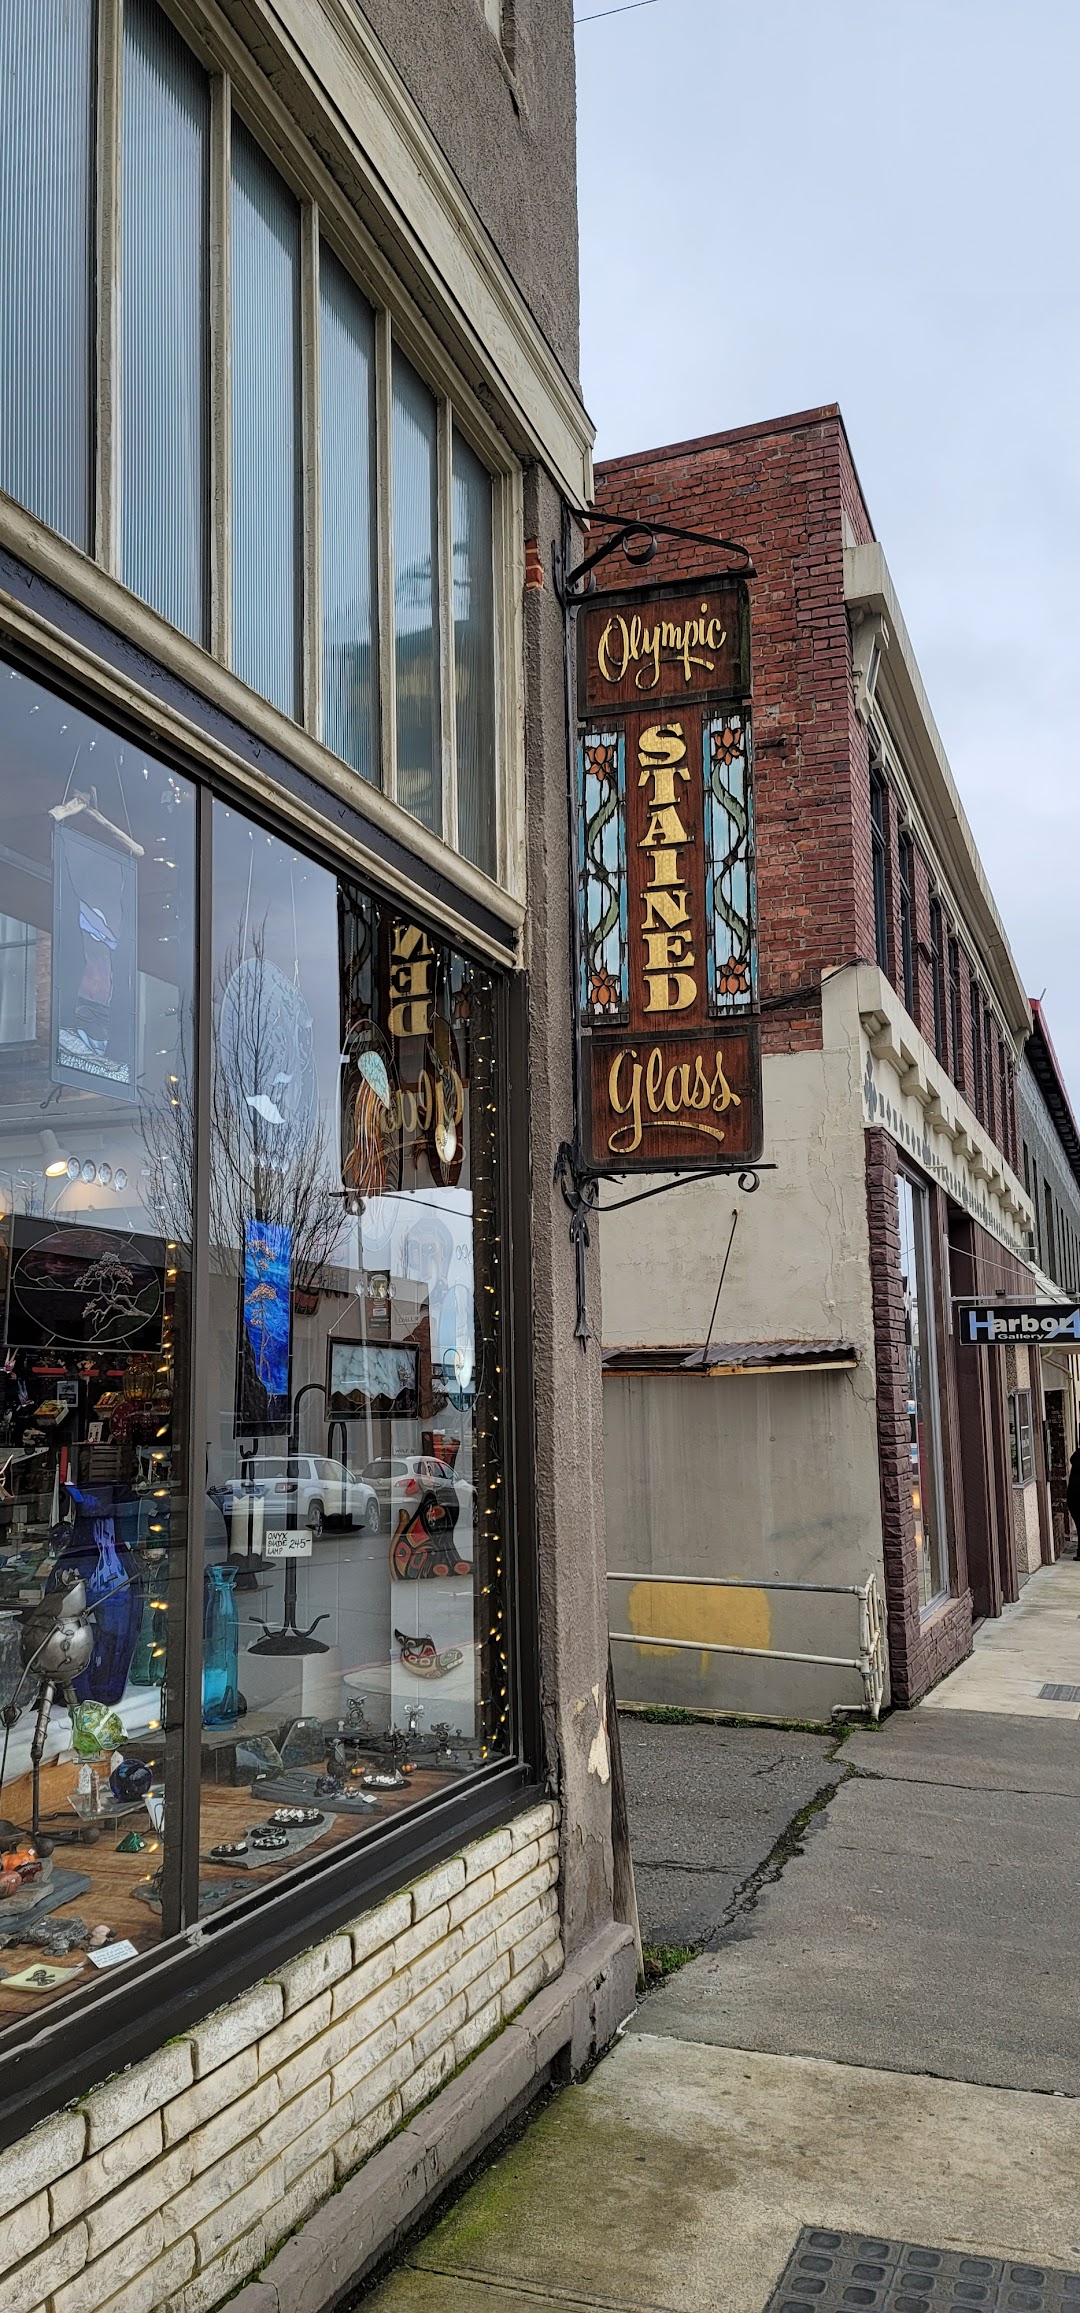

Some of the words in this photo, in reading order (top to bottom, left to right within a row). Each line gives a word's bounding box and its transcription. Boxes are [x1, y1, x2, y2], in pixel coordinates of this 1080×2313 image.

[597, 602, 727, 690] Olympic
[637, 722, 698, 1013] STAINED
[608, 1047, 742, 1154] Glass
[968, 1310, 1069, 1340] Harbor
[267, 1532, 288, 1540] ONYX
[267, 1547, 283, 1555] LAMP
